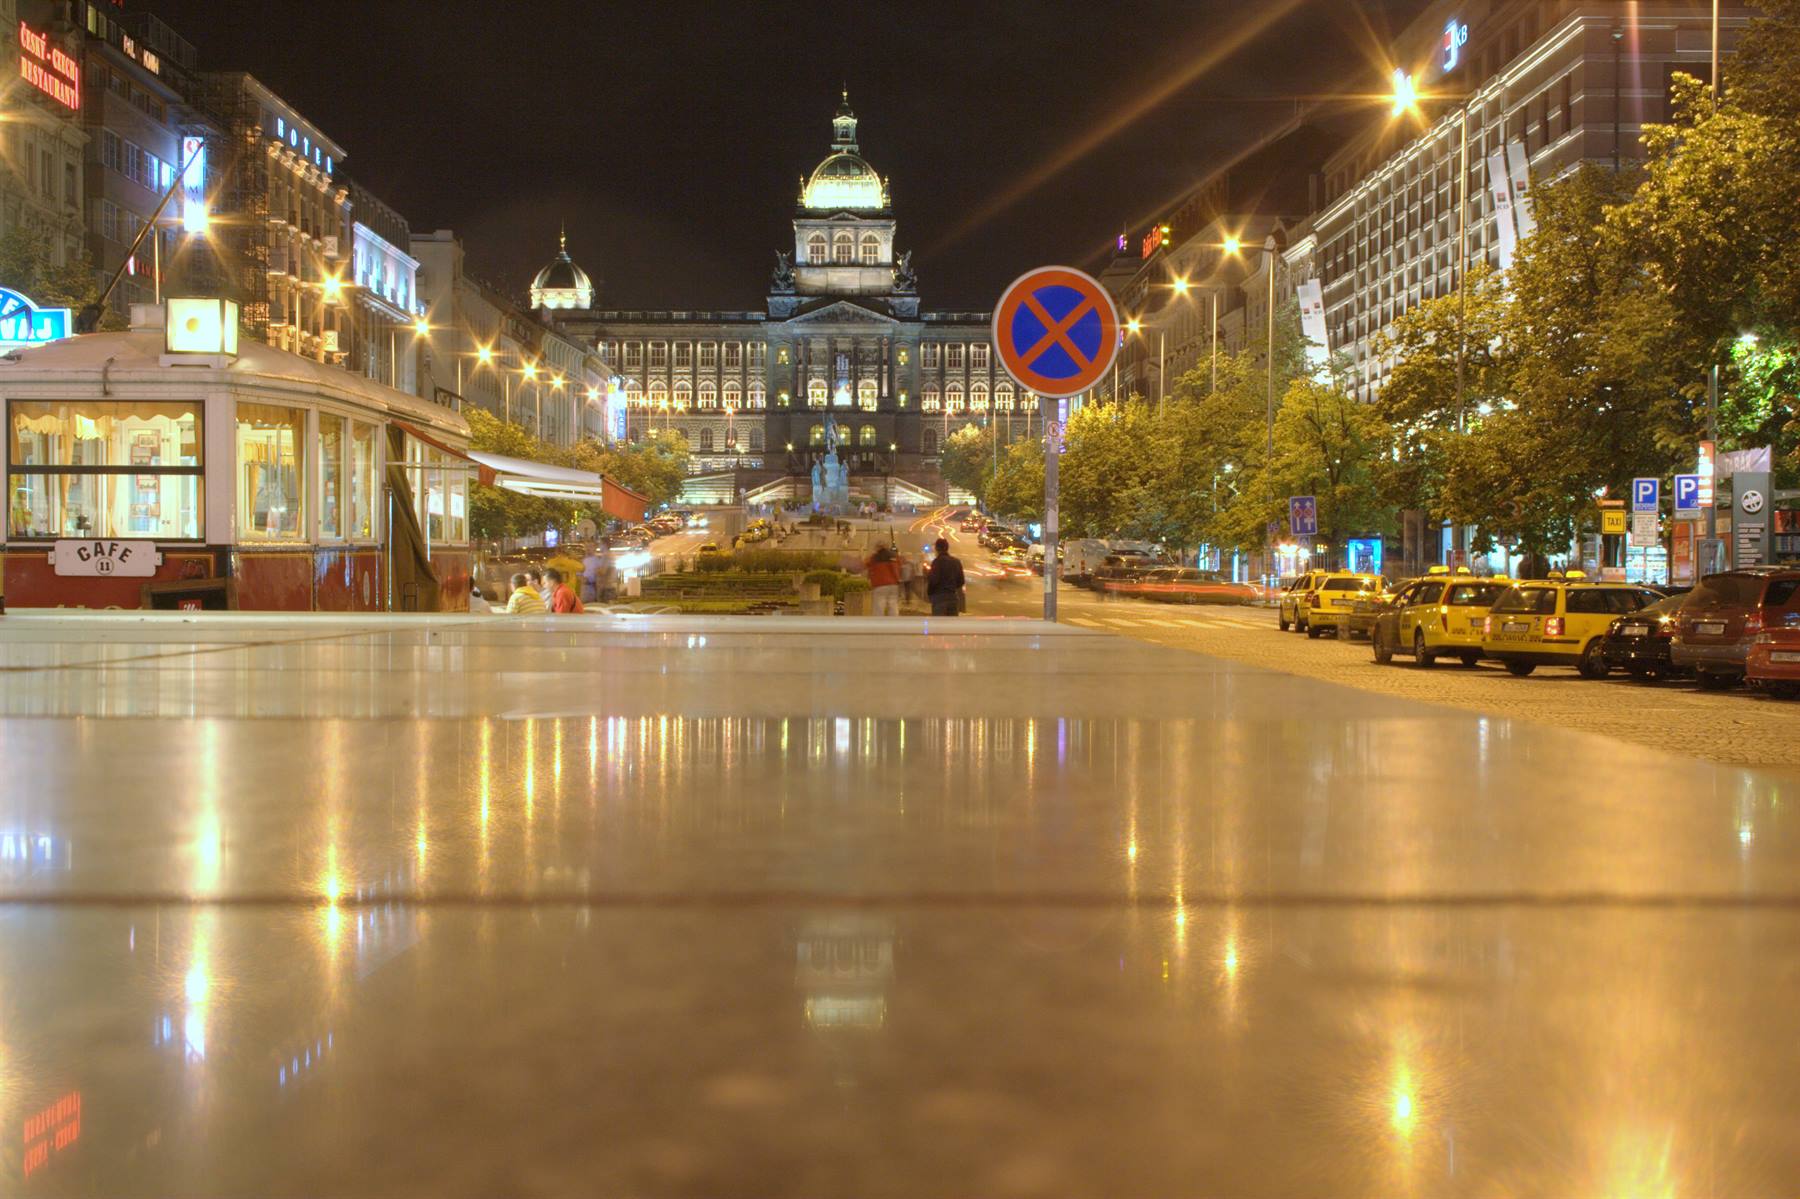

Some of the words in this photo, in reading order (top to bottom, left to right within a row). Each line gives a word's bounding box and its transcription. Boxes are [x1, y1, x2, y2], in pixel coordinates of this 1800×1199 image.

[20, 56, 75, 110] RESTAURANT
[277, 117, 332, 174] HOTEL
[1638, 482, 1654, 502] P
[1680, 478, 1696, 500] P
[1606, 517, 1622, 526] TAXI
[77, 541, 133, 563] CAFE
[100, 561, 110, 571] 11
